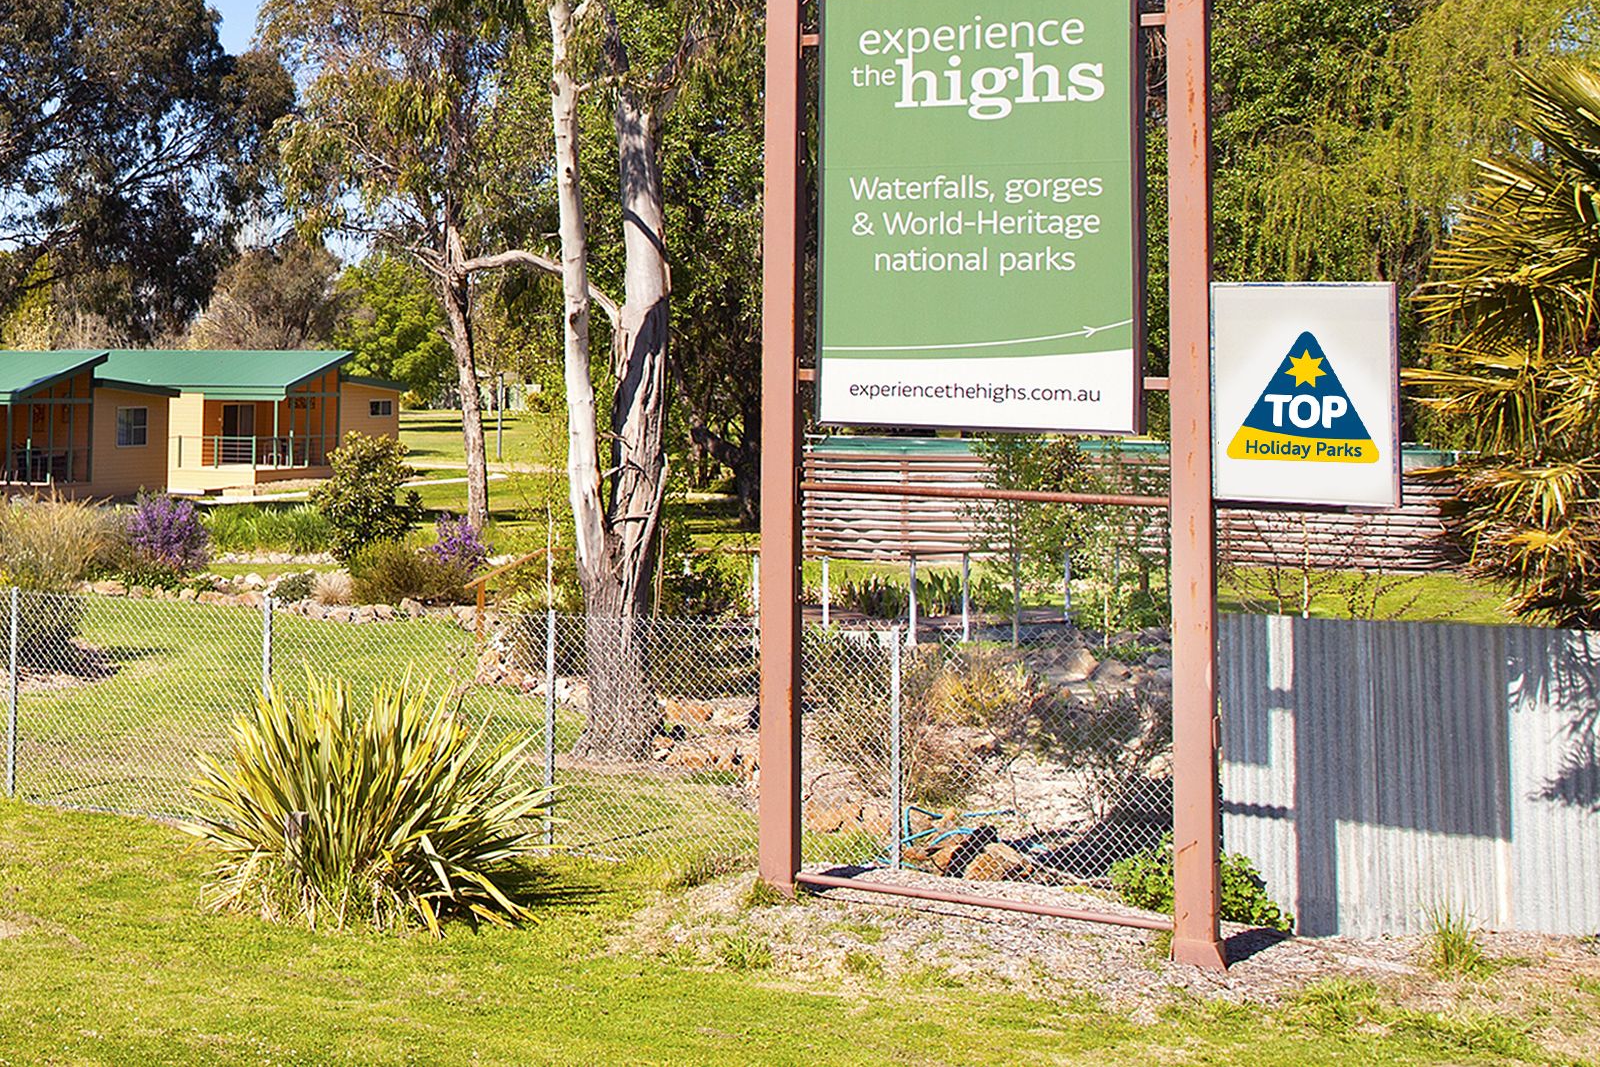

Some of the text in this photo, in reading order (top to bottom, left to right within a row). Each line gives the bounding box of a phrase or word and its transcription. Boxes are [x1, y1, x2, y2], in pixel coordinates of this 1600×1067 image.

[859, 15, 1085, 60] experience
[850, 52, 1105, 120] the highs
[849, 174, 1103, 204] Waterfalls, gorges
[851, 209, 1100, 240] & World-Heritage
[875, 246, 1076, 277] national parks
[849, 381, 1101, 404] experiencethehighs.com.au
[1264, 393, 1348, 429] TOP
[1245, 439, 1362, 459] Holiday Parks
